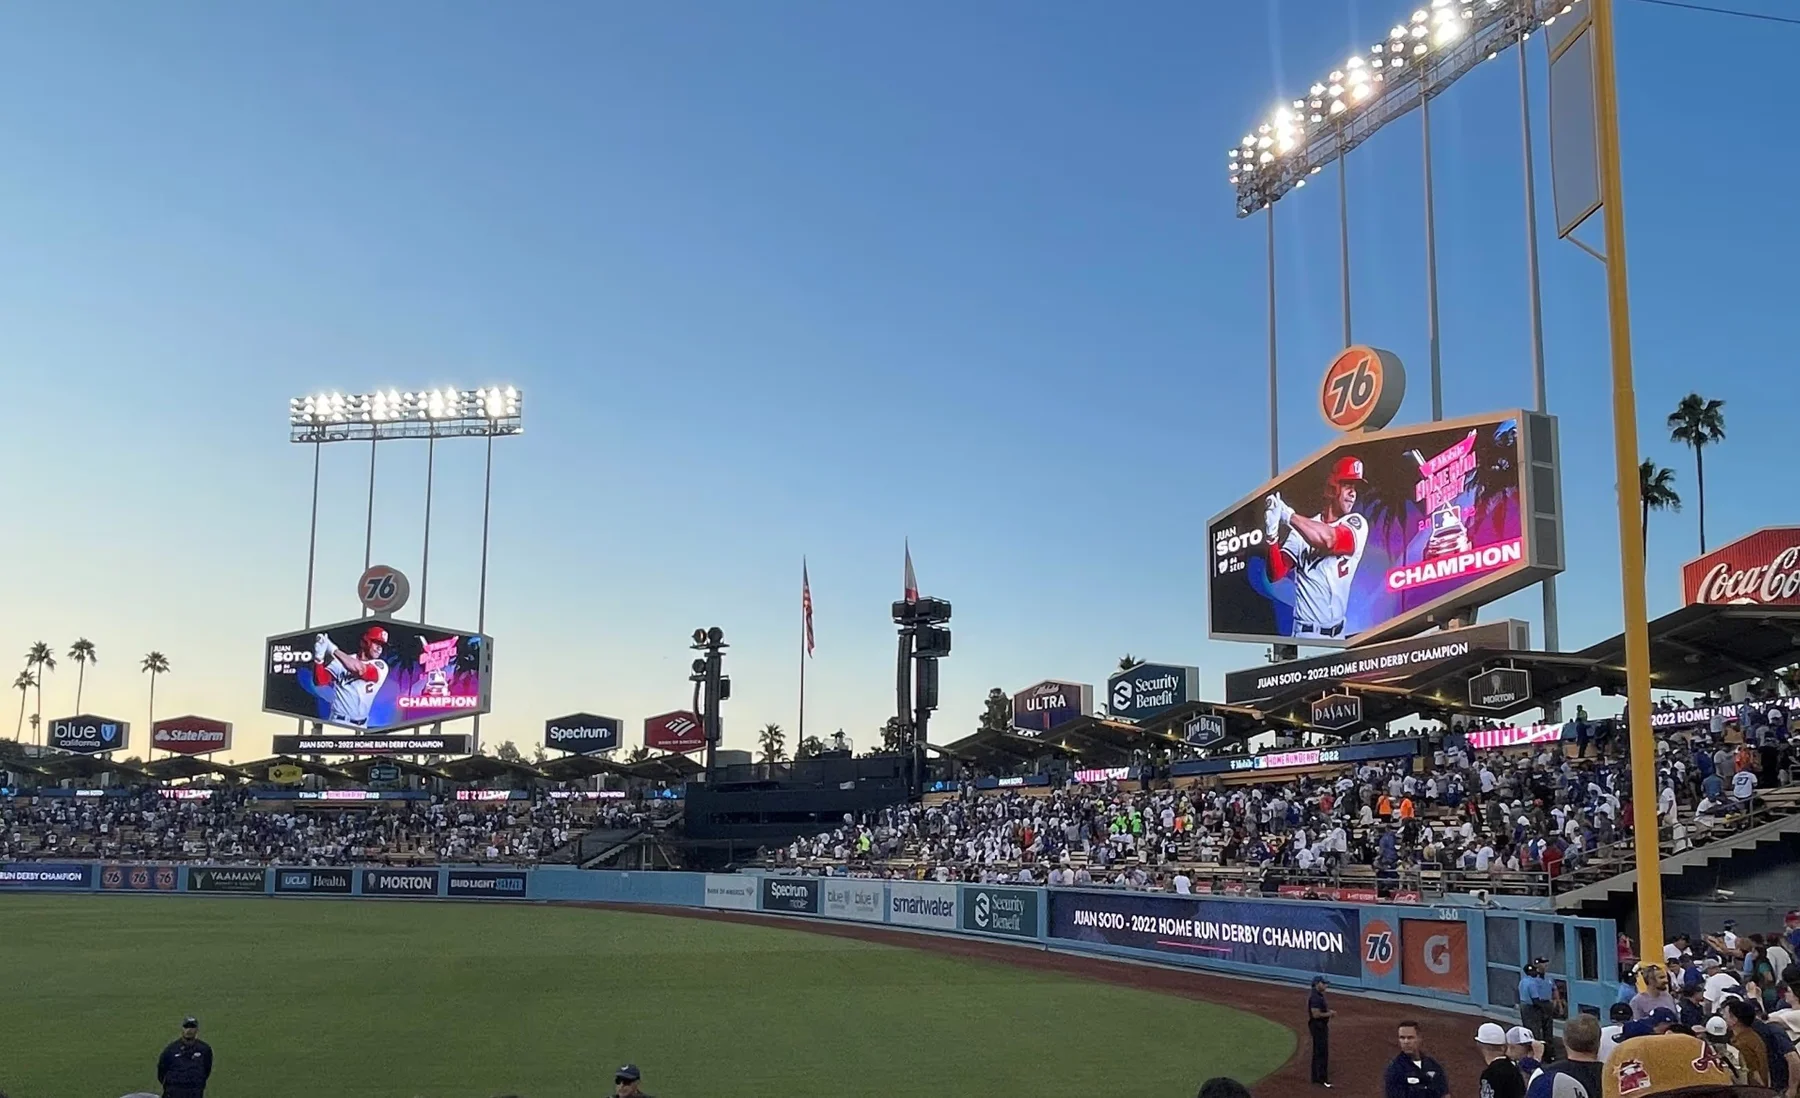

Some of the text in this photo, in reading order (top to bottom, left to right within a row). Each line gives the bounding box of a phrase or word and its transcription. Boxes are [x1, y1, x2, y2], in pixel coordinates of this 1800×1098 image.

[1328, 356, 1376, 418] 76
[1216, 526, 1236, 541] JUAN
[1216, 529, 1263, 556] SOTO
[1389, 542, 1521, 589] CHAMPION
[364, 573, 396, 601] 76
[273, 651, 312, 662] SOTO
[1257, 676, 1279, 689] JUAN
[1279, 672, 1302, 686] SOTO
[1308, 668, 1329, 681] 2022
[1330, 662, 1357, 676] HOME
[1359, 658, 1379, 672] RUN
[1380, 652, 1409, 668] DERBY
[1410, 642, 1469, 663] CHAMPION
[1135, 674, 1179, 692] Security
[399, 696, 477, 707] CHAMPION
[1026, 694, 1067, 711] ULTRA
[1136, 690, 1172, 708] Benefit
[1483, 693, 1514, 704] MORTON
[1315, 703, 1356, 720] DASANI
[1652, 712, 1675, 726] 2022
[1677, 708, 1710, 723] HOME
[55, 722, 96, 739] blue
[550, 726, 608, 742] Spectrum
[1187, 722, 1200, 741] JIM
[1201, 718, 1221, 736] BEAM
[60, 739, 100, 747] california
[1319, 750, 1339, 761] 2022
[1736, 777, 1749, 786] 27
[16, 872, 39, 880] DERBY
[40, 872, 82, 881] CHAMPION
[106, 871, 121, 885] 76
[131, 871, 147, 885] 76
[157, 871, 173, 885] 76
[285, 876, 307, 885] UCLA
[313, 875, 346, 887] Health
[380, 876, 432, 890] MORTON
[451, 879, 469, 888] BUD
[470, 879, 495, 888] LIGHT
[772, 882, 808, 898] Spectrum
[893, 896, 954, 917] smartwater
[992, 894, 1025, 915] Security
[993, 912, 1020, 930] Benefit
[1439, 908, 1458, 920] 360
[1073, 910, 1097, 926] JUAN
[1098, 912, 1124, 929] SOTO
[1131, 915, 1157, 932] 2022
[1158, 917, 1192, 936] HOME
[1194, 920, 1219, 940] RUN
[1222, 923, 1260, 944] DERBY
[1262, 927, 1343, 953] CHAMPION
[1366, 931, 1393, 963] 76
[1424, 935, 1449, 974] G
